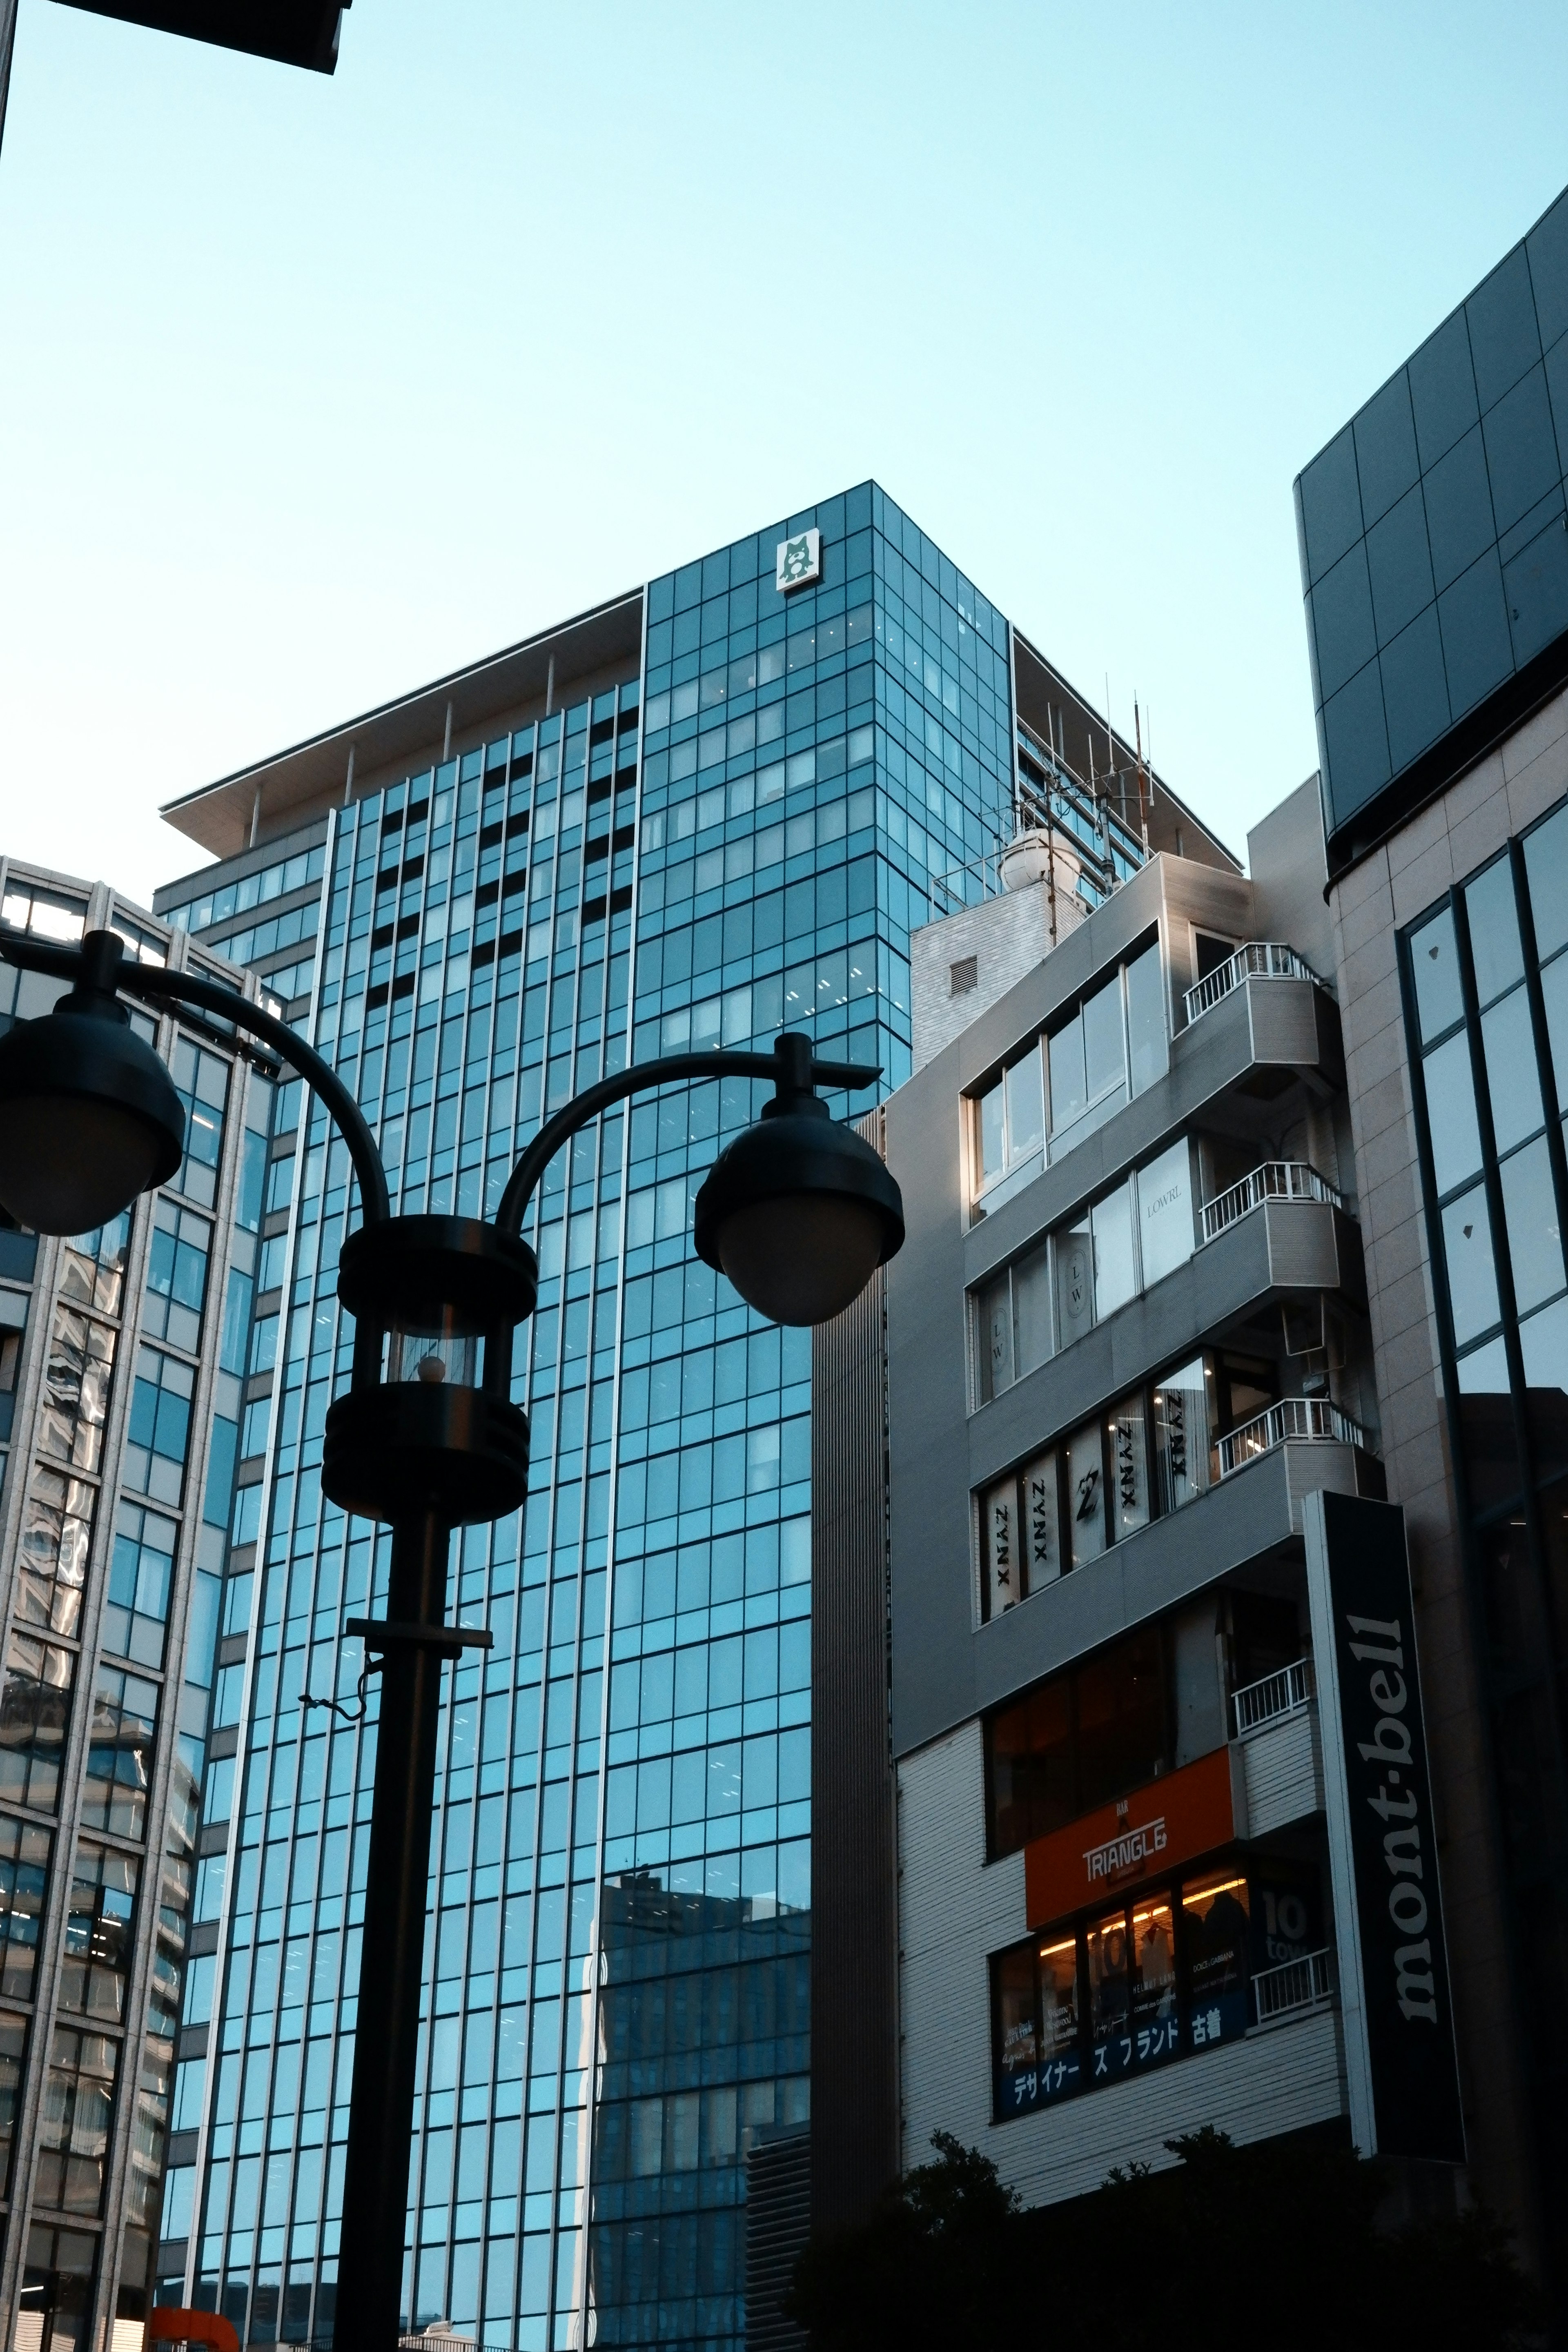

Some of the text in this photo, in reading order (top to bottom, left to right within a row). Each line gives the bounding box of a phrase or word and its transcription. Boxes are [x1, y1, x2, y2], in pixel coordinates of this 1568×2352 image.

[1117, 1800, 1128, 1816] BAR
[1082, 1816, 1167, 1882] TRIANGLE
[1262, 1891, 1307, 1940] 10
[1193, 1960, 1208, 1973] DOLCE
[1210, 1951, 1234, 1965] GABBANA
[1133, 1978, 1156, 1995] HELMUT
[1192, 2007, 1221, 2045] 古着
